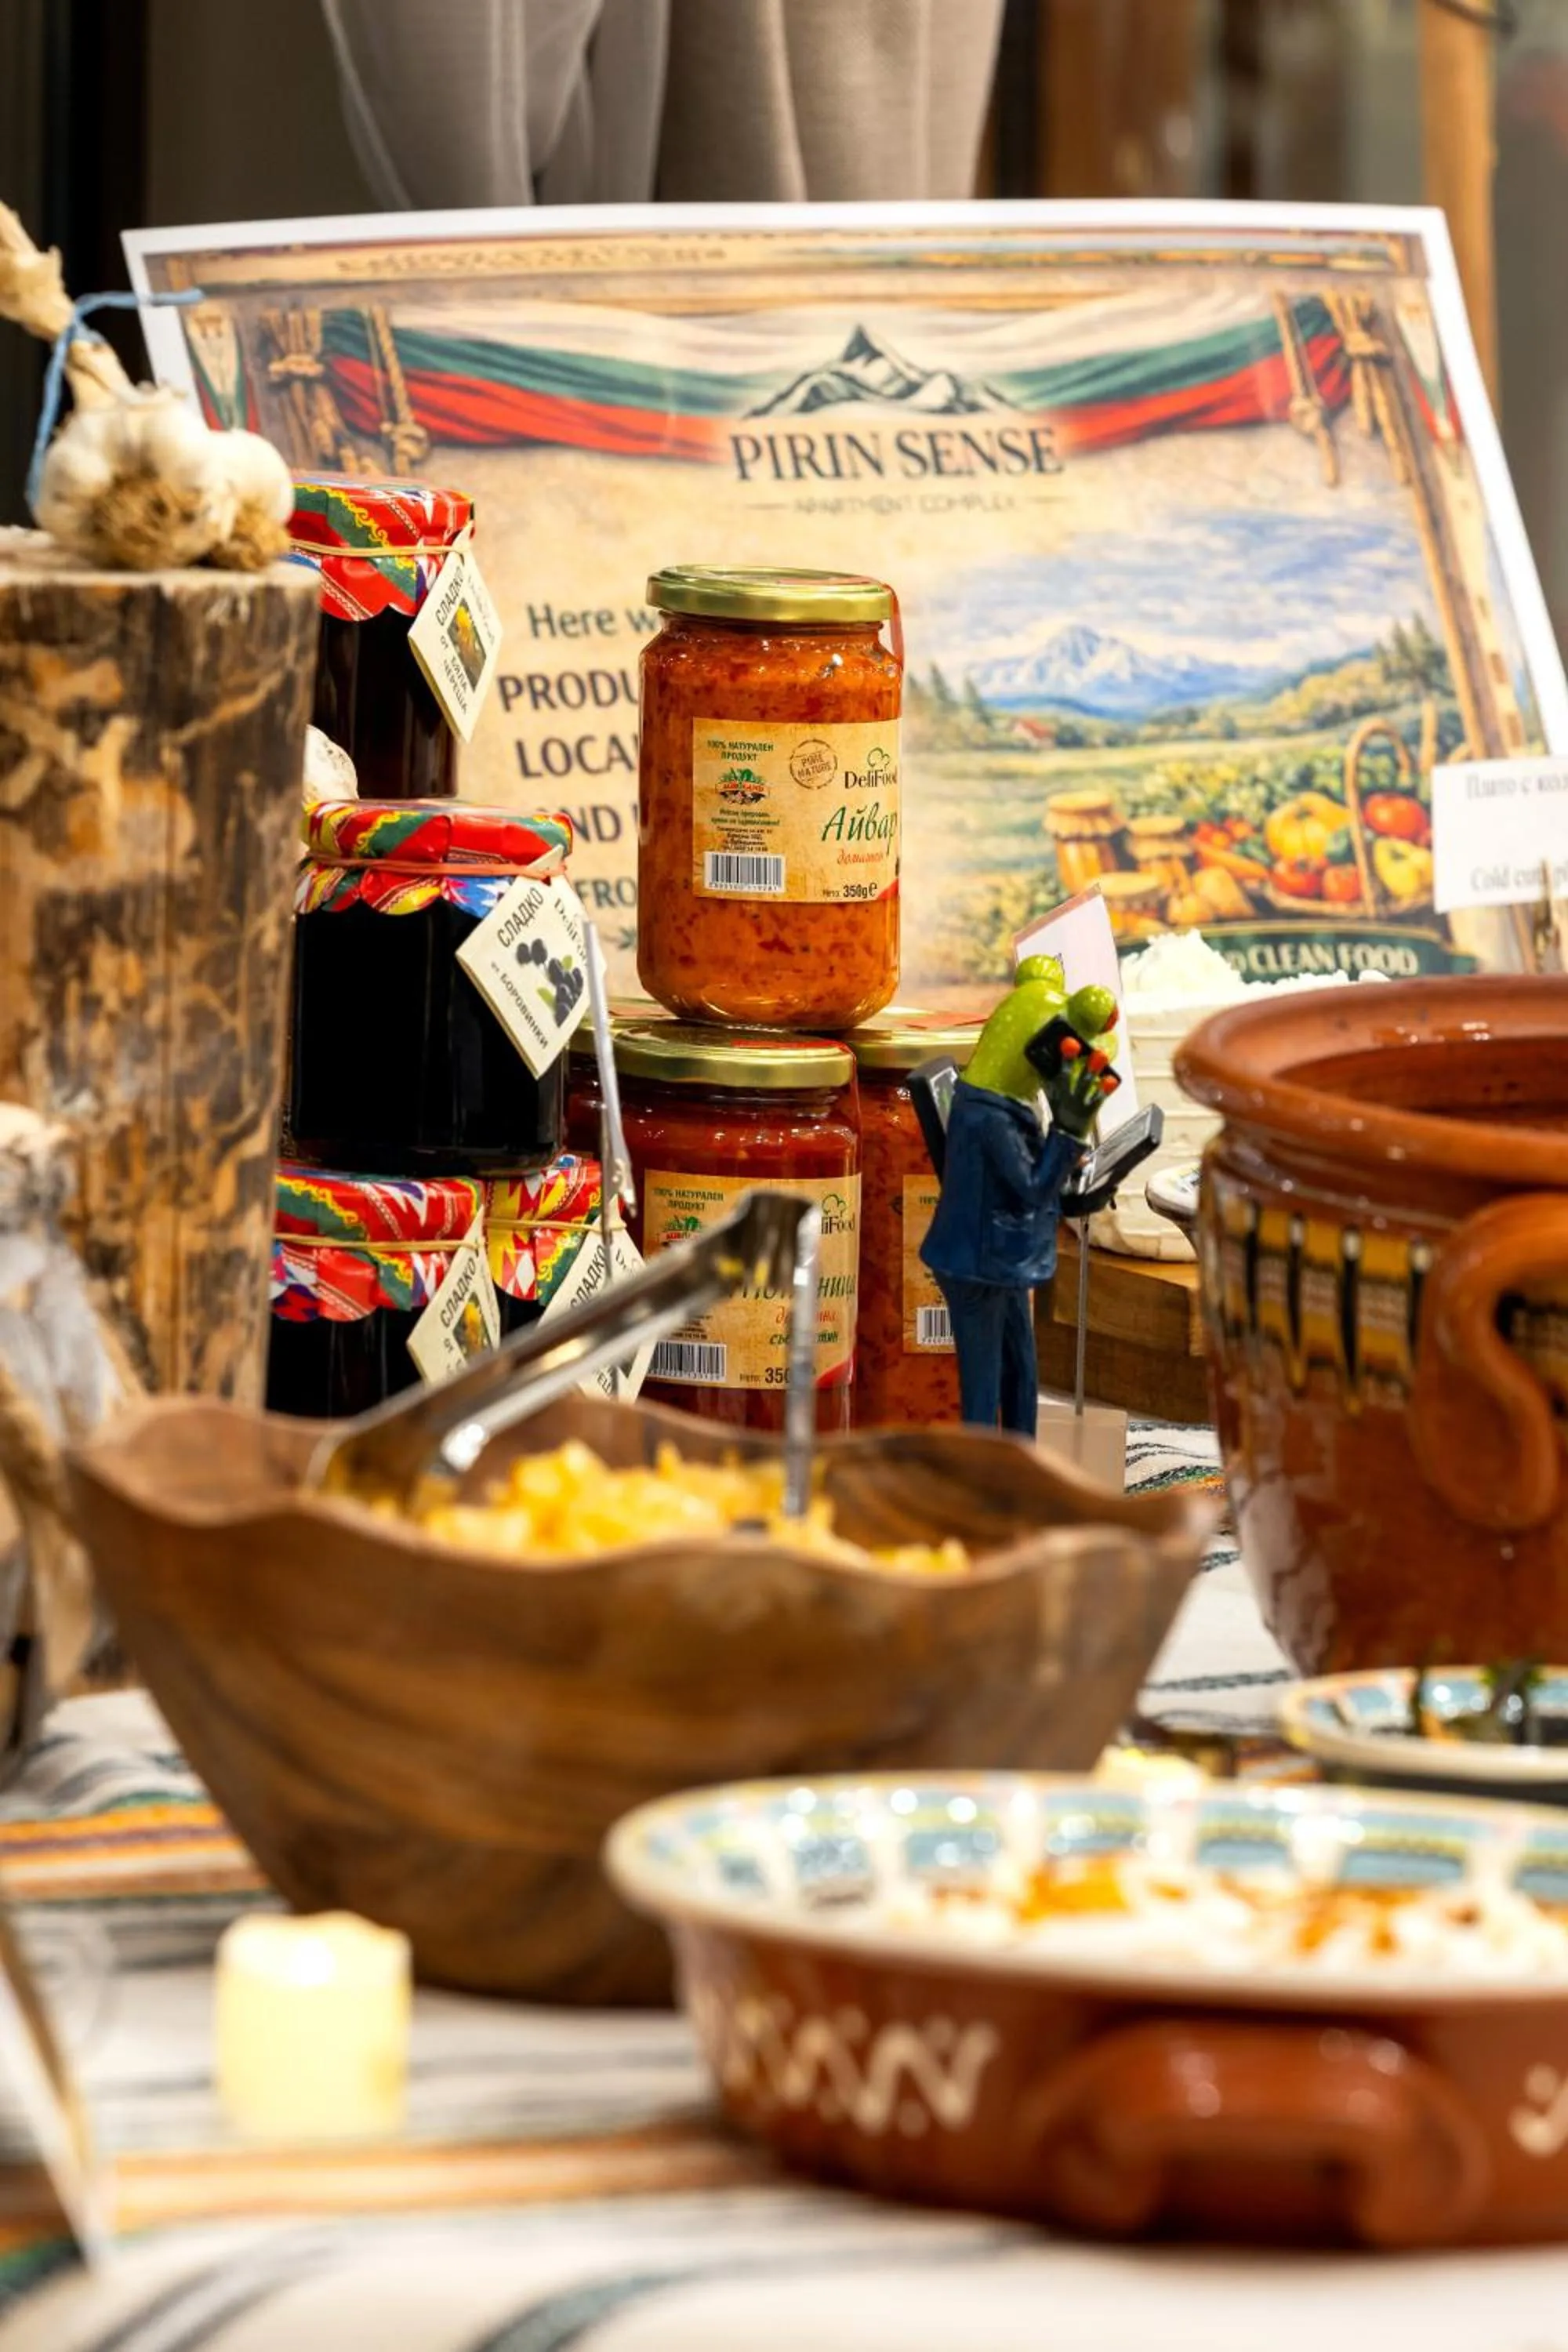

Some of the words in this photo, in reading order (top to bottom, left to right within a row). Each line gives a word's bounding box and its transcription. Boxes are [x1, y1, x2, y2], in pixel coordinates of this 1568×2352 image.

[730, 431, 885, 481] PIRIN
[894, 426, 1065, 480] SENSE
[526, 603, 617, 639] Here
[625, 608, 660, 632] w
[497, 670, 638, 713] PRODU
[514, 734, 638, 779] LOCA
[720, 752, 758, 762] ПРОДУКТ
[538, 806, 623, 844] ND
[821, 801, 898, 855] Айвар
[573, 876, 637, 910] FRO
[496, 887, 545, 949] СЛАДКО
[1337, 942, 1419, 976] FOOD
[501, 973, 549, 1050] БОРОВИНКИ
[820, 1213, 855, 1235] liFood
[439, 1256, 477, 1329] СЛАДКО
[764, 1367, 790, 1385] 35
